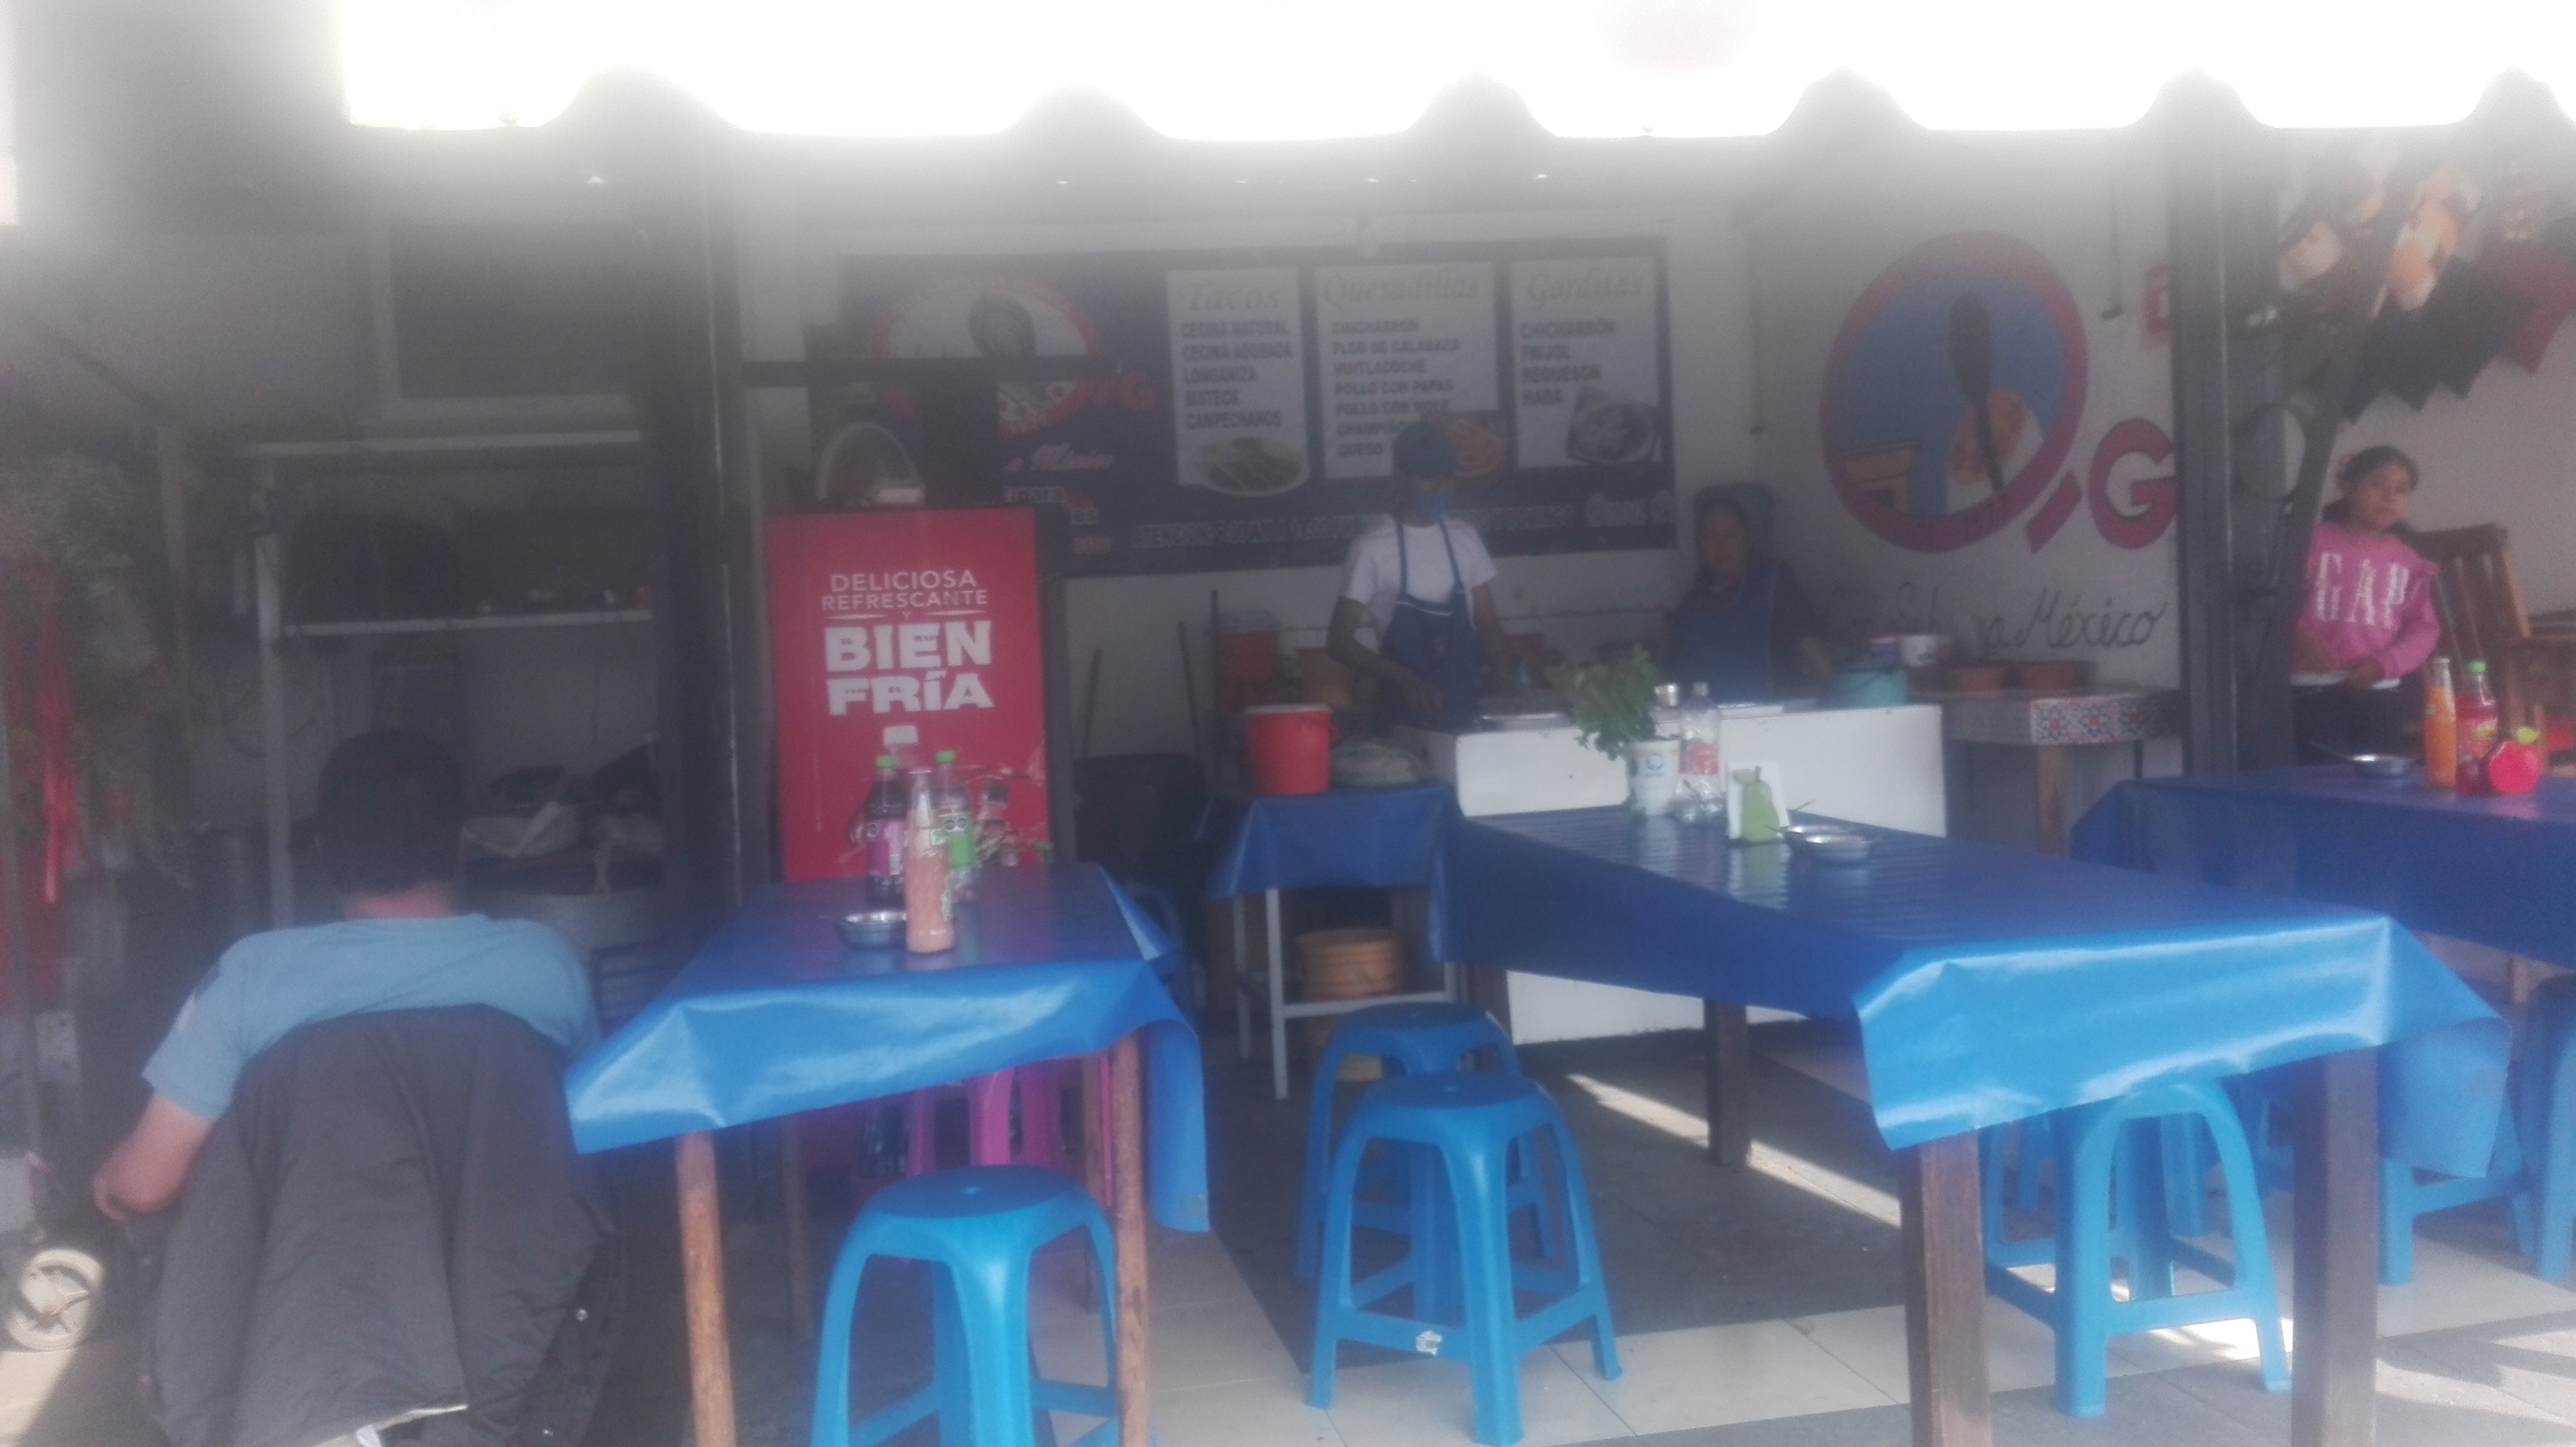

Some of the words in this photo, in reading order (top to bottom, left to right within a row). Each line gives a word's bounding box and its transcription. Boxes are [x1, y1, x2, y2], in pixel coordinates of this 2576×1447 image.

[1181, 281, 1281, 310] Tacos
[1181, 321, 1228, 338] CECINA
[1231, 319, 1289, 336] NATURAL
[1181, 344, 1229, 361] CECINA
[1331, 341, 1366, 356] FLOR
[1370, 340, 1388, 354] DE
[1391, 338, 1460, 354] CALABAZA
[1183, 365, 1258, 384] LONGANIZA
[1334, 382, 1377, 396] POLLO
[1381, 380, 1409, 395] CON
[1412, 378, 1453, 393] PAPAS
[1336, 402, 1378, 417] POLLO
[1382, 401, 1409, 414] CON
[1338, 442, 1385, 458] QUESO
[830, 569, 978, 593] DELICIOSA
[2314, 551, 2411, 631] GAP
[821, 589, 988, 611] REFRESCANTE
[2016, 586, 2168, 650] México
[824, 619, 993, 673] BIEN
[826, 669, 995, 717] FRÍA
